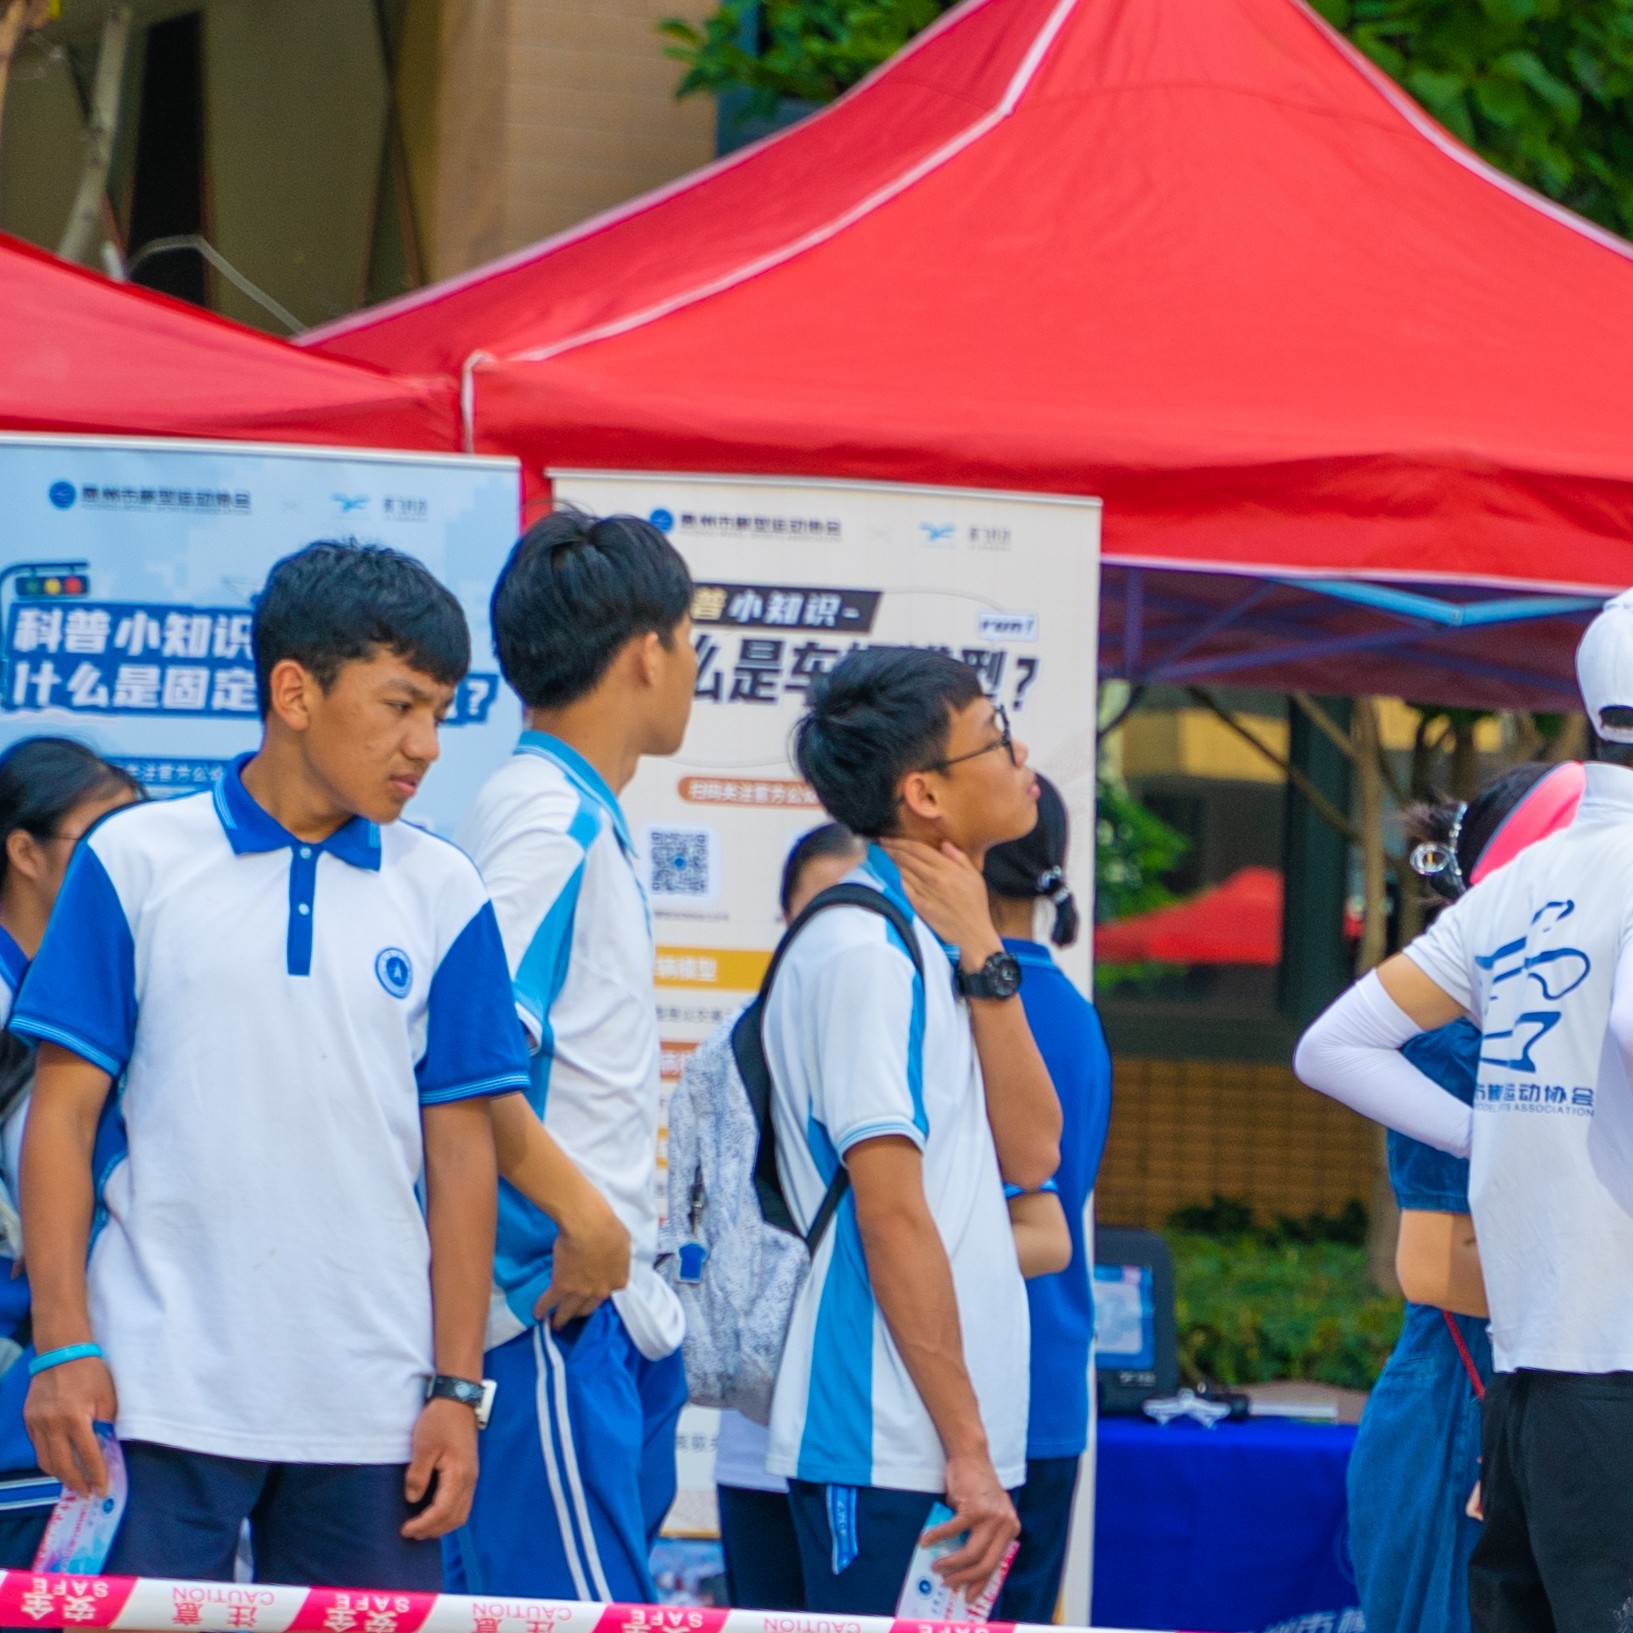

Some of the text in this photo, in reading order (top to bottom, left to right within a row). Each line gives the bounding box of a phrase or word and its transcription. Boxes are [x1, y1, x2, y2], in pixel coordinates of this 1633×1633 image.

[13, 607, 253, 659] 科普小知识
[32, 1577, 109, 1598] SAFE
[172, 1586, 275, 1607] CAUTION
[21, 1590, 96, 1622] 安全
[333, 1592, 411, 1613] SAFE
[472, 1603, 572, 1622] CAUTION
[173, 1600, 258, 1627] 注意
[323, 1605, 398, 1633] 安全
[629, 1609, 704, 1629] SAFE
